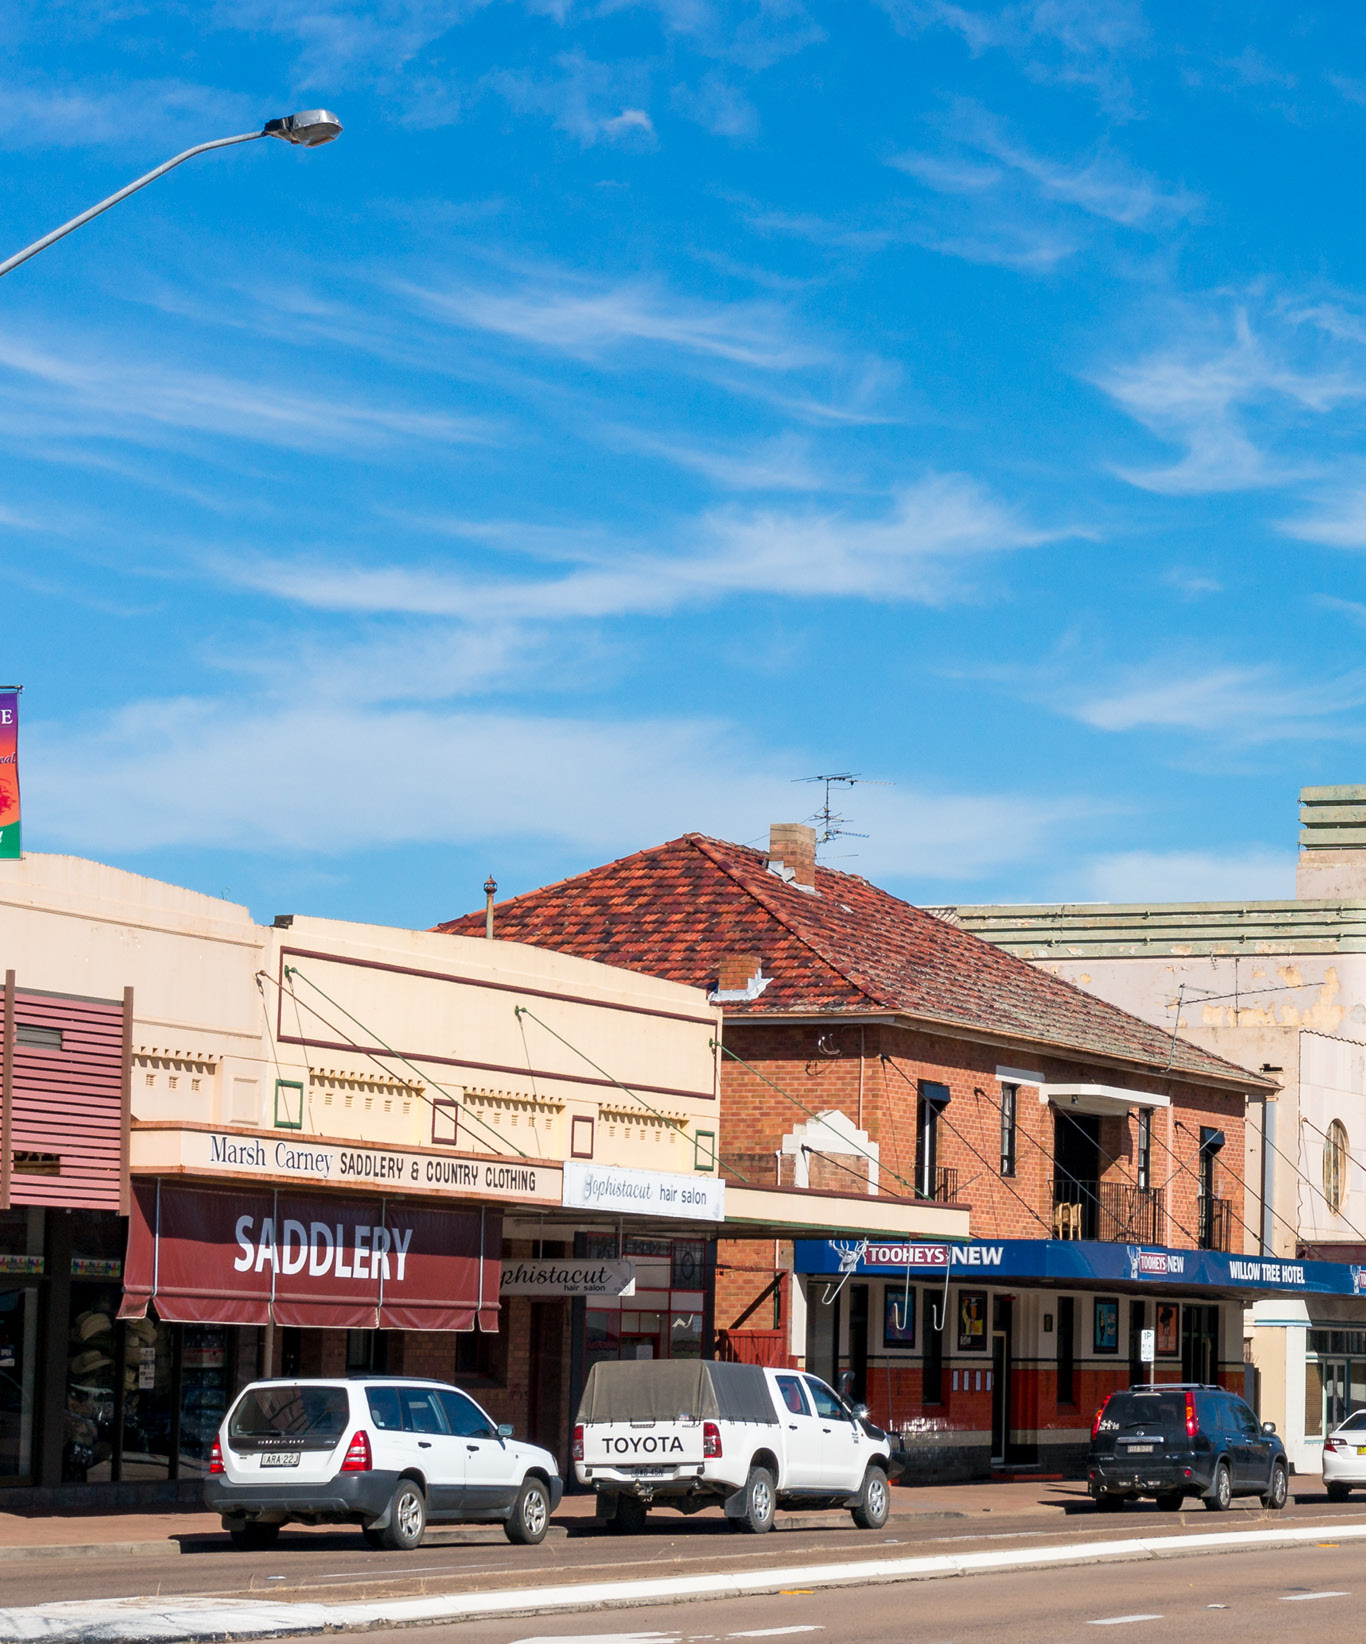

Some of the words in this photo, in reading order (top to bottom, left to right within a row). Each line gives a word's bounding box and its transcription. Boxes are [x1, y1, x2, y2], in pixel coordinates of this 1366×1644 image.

[210, 1135, 266, 1166] Marsh
[275, 1142, 333, 1178] Carney
[340, 1152, 404, 1179] SADDLERY
[410, 1161, 420, 1181] &
[426, 1160, 479, 1186] COUNTRY
[485, 1166, 536, 1192] CLOTHING
[659, 1184, 678, 1202] hair
[681, 1187, 707, 1205] salon
[233, 1215, 413, 1281] SADDLERY
[868, 1247, 945, 1263] TOOHEYS
[951, 1246, 1004, 1266] NEW
[1140, 1256, 1166, 1271] TOOHEYS
[1167, 1255, 1185, 1273] NEW
[1229, 1260, 1260, 1281] WILLOW
[1261, 1264, 1281, 1283] TREE
[1281, 1266, 1306, 1284] HOTEL
[499, 1264, 613, 1289] phistacut
[564, 1284, 579, 1292] hair
[583, 1284, 606, 1292] salon
[601, 1437, 684, 1454] TOYOTA
